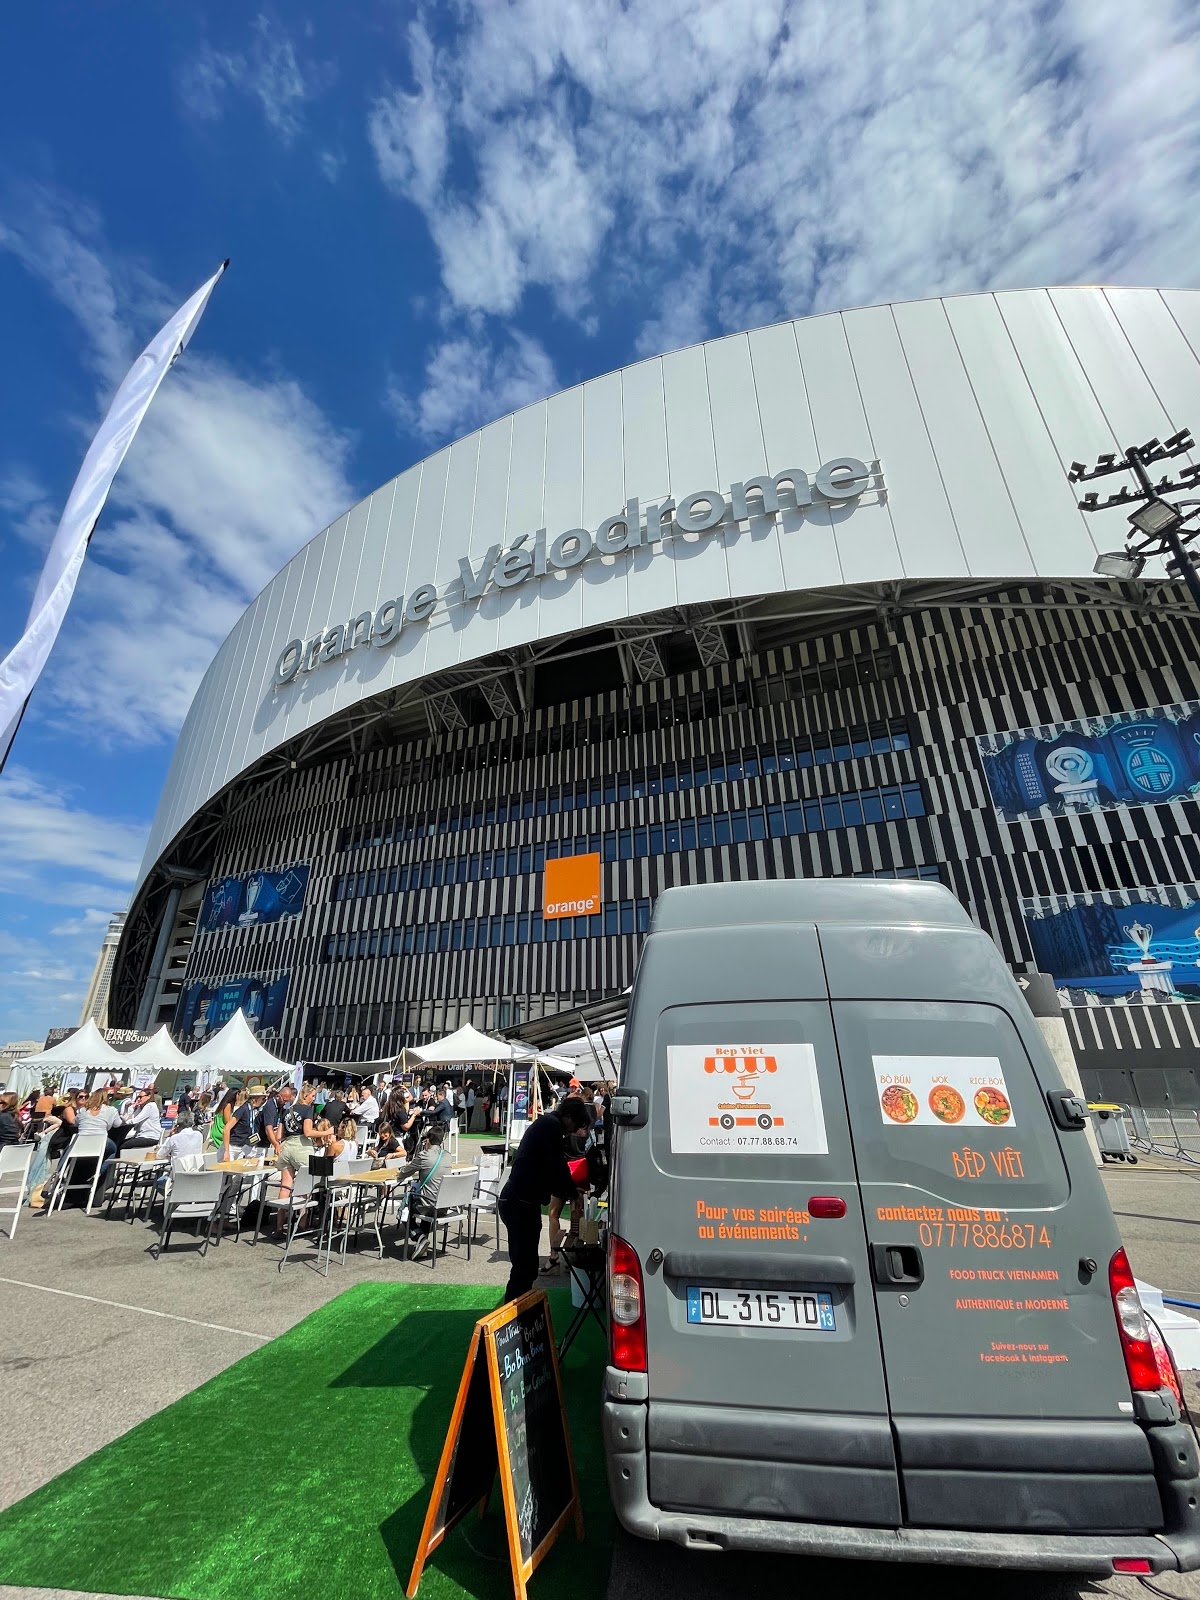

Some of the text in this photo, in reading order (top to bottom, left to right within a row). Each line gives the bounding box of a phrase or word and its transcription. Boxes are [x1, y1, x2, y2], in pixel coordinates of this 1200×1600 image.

[274, 456, 869, 686] Orange Vélodrome
[546, 899, 594, 914] orange
[104, 1028, 139, 1036] TRIBUNE
[716, 1048, 737, 1056] Bep
[700, 1137, 731, 1146] Contact
[737, 1138, 798, 1146] 07.77.88.68.74
[952, 1146, 1024, 1178] BÊP VIÊT
[696, 1200, 810, 1224] Pour vos soirées
[877, 1205, 944, 1221] contactez
[947, 1208, 980, 1221] nous
[984, 1210, 1000, 1221] au
[698, 1225, 715, 1239] ou
[718, 1223, 799, 1240] événements
[919, 1223, 1051, 1248] 0777886874
[950, 1270, 1059, 1280] FOOD TRUCK VIETNAMIEN
[956, 1299, 1014, 1310] AUTHENTIQUE
[1025, 1300, 1069, 1310] MODERNE
[692, 1308, 697, 1316] F
[821, 1311, 832, 1326] 13
[991, 1342, 1036, 1351] Suivez-nous
[980, 1354, 1020, 1362] Facebook
